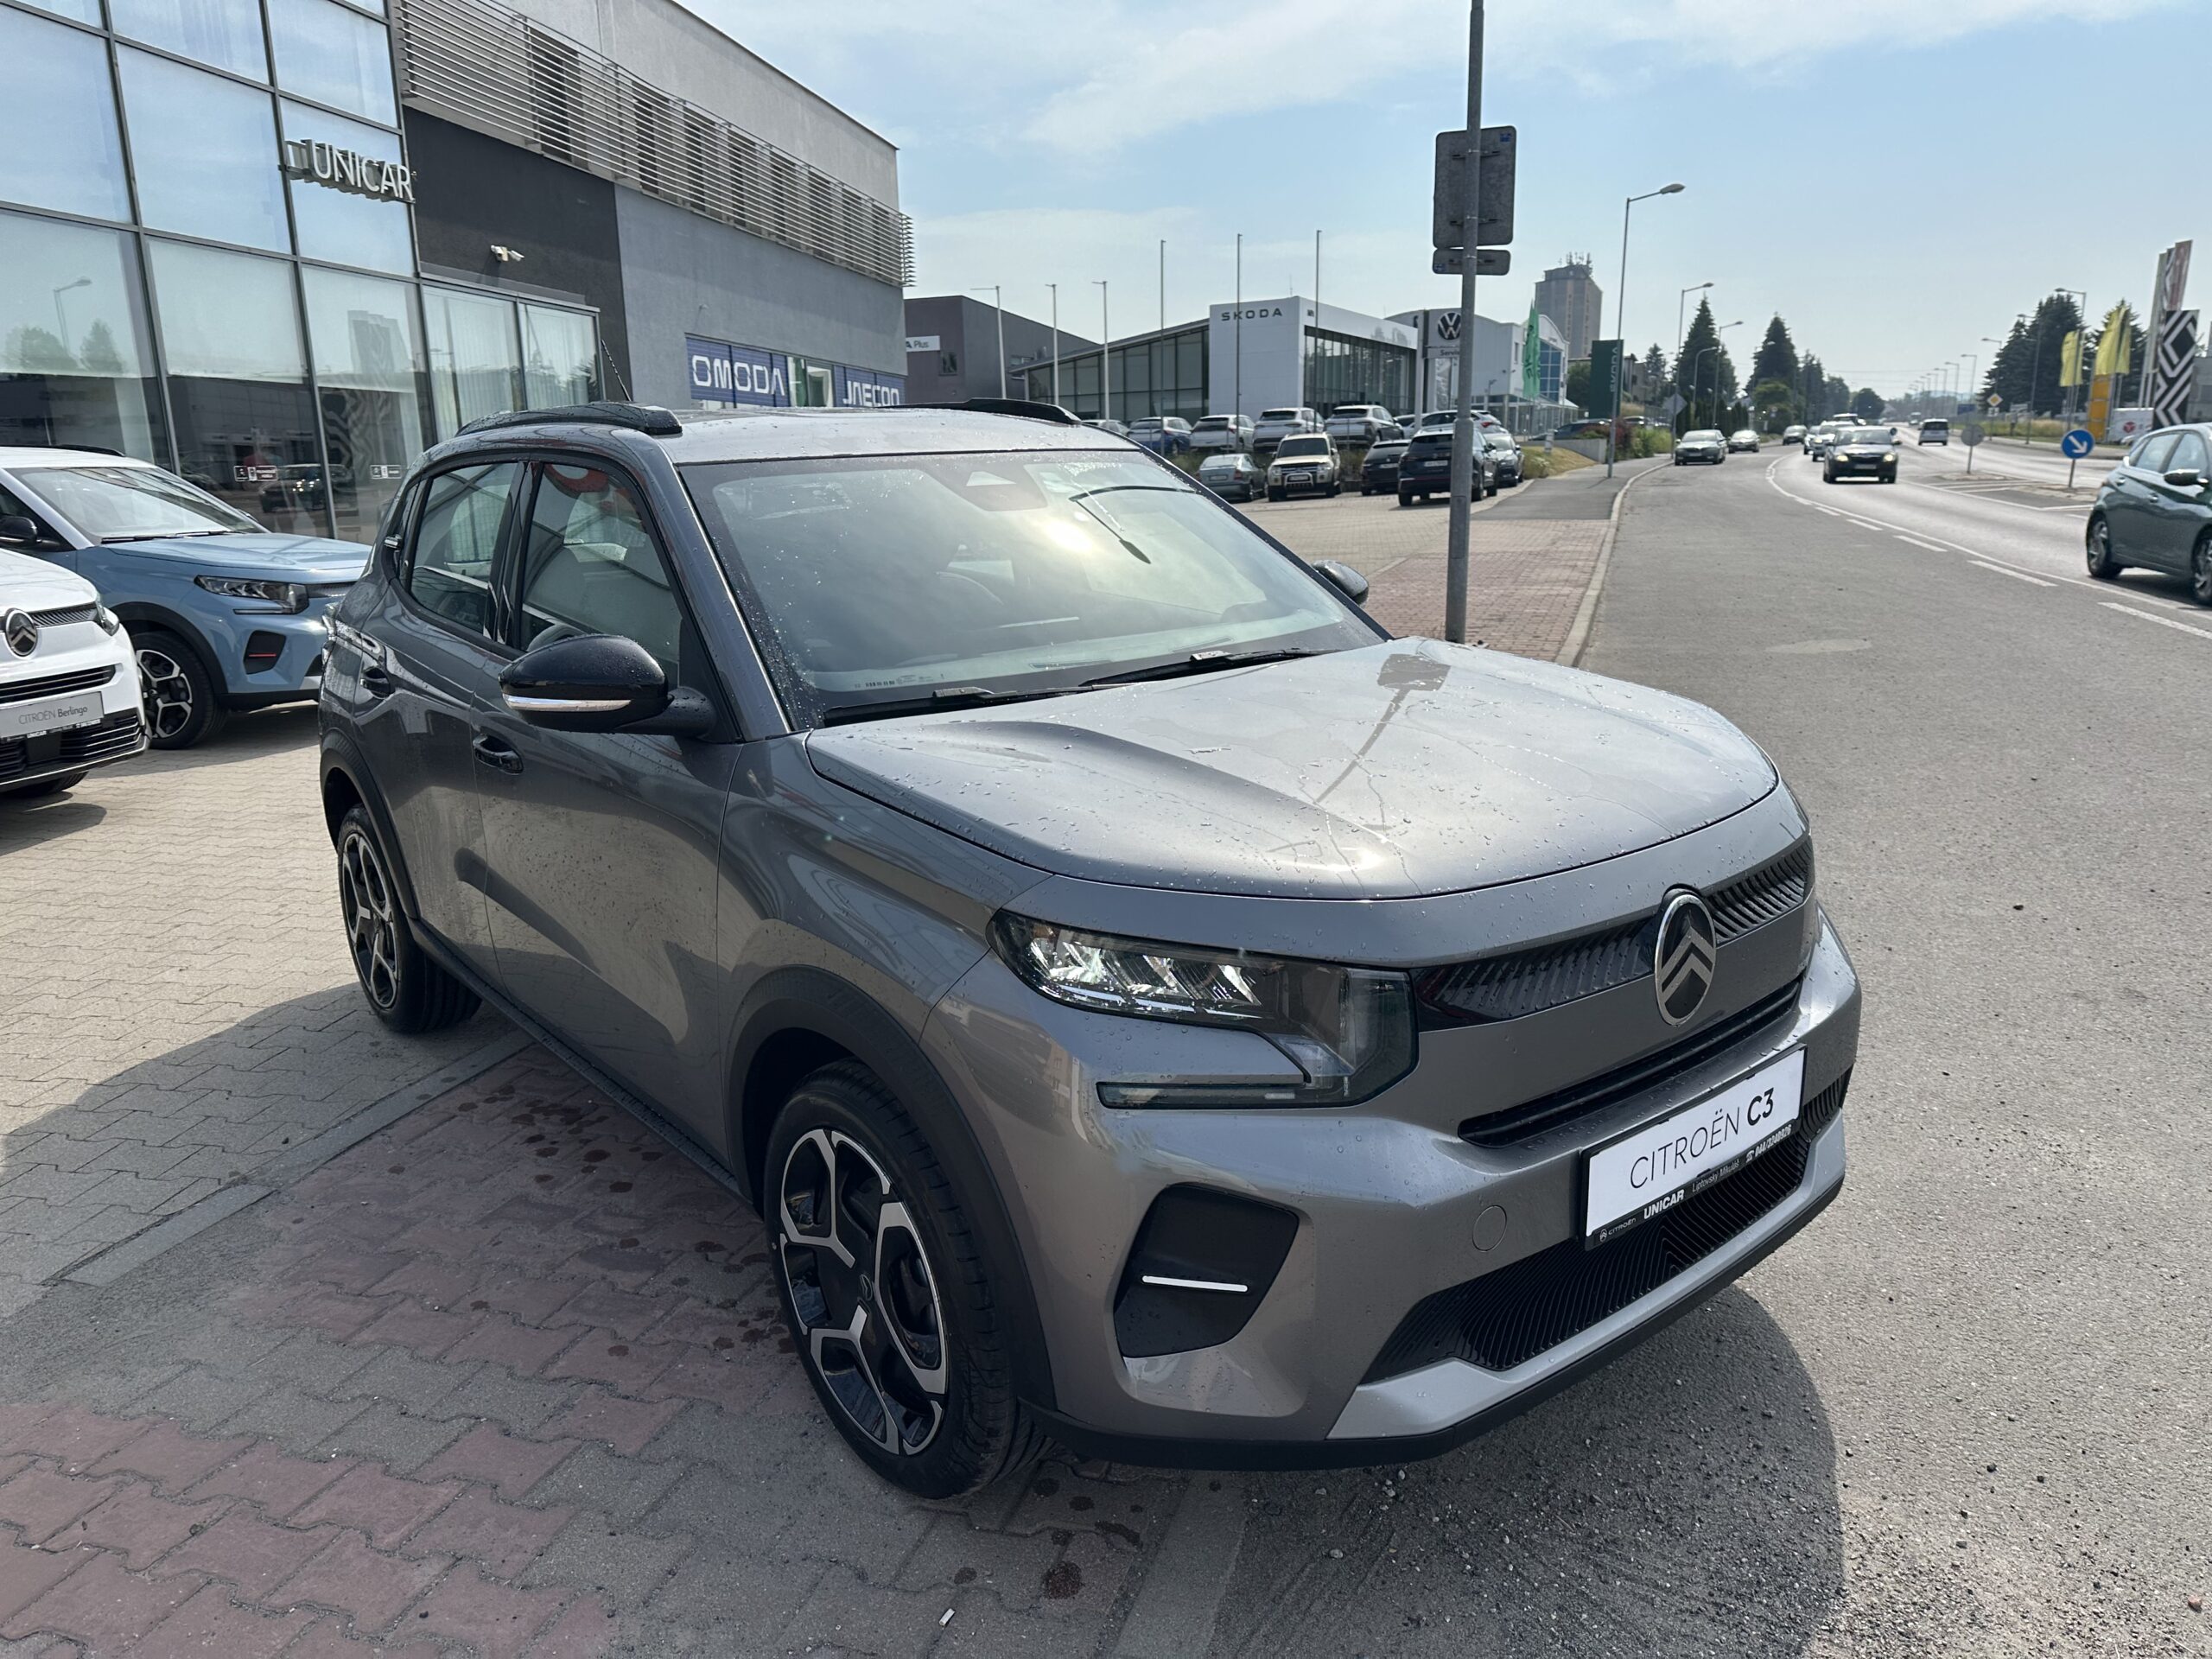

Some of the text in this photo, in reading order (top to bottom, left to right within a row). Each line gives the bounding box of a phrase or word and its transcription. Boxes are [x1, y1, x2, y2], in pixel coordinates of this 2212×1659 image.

[311, 139, 414, 200] UNICAR
[692, 355, 785, 396] OMODA
[842, 380, 900, 407] JAECOO
[57, 706, 88, 718] Berlingo
[1630, 1087, 1775, 1189] CITROËN C3
[1643, 1189, 1685, 1220] UNICAR
